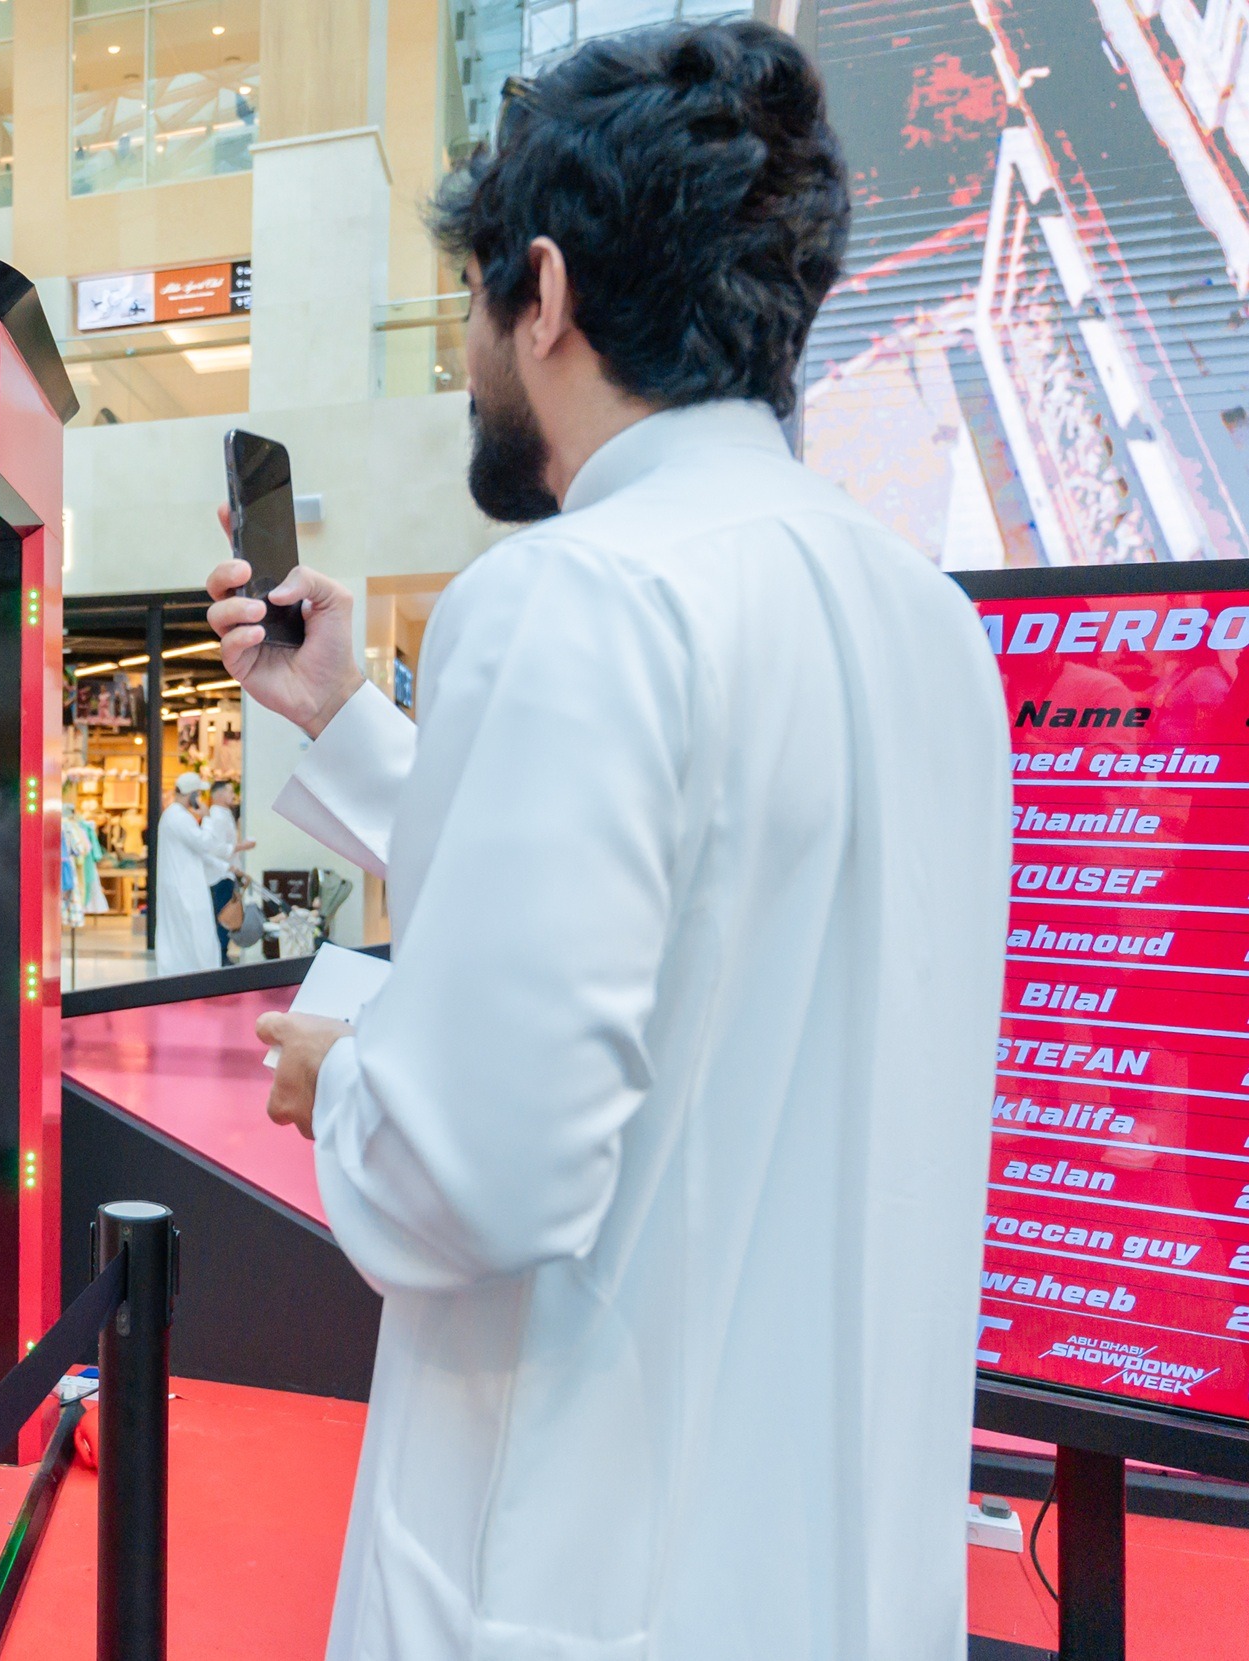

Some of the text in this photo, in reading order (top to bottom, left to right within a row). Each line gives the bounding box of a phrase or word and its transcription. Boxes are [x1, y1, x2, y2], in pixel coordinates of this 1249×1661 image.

[1014, 701, 1151, 728] Name
[1089, 748, 1220, 777] qasim
[1020, 982, 1117, 1013] Bilal
[997, 1038, 1150, 1075] STEFAN
[992, 1096, 1135, 1135] khalifa
[1003, 1160, 1116, 1191] aslan
[1123, 1236, 1201, 1266] guy
[980, 1270, 1136, 1313] waheeb
[1066, 1335, 1144, 1355] ABU DHABI
[1050, 1343, 1204, 1381] SHOWDOWN
[1122, 1372, 1195, 1396] WEEK
